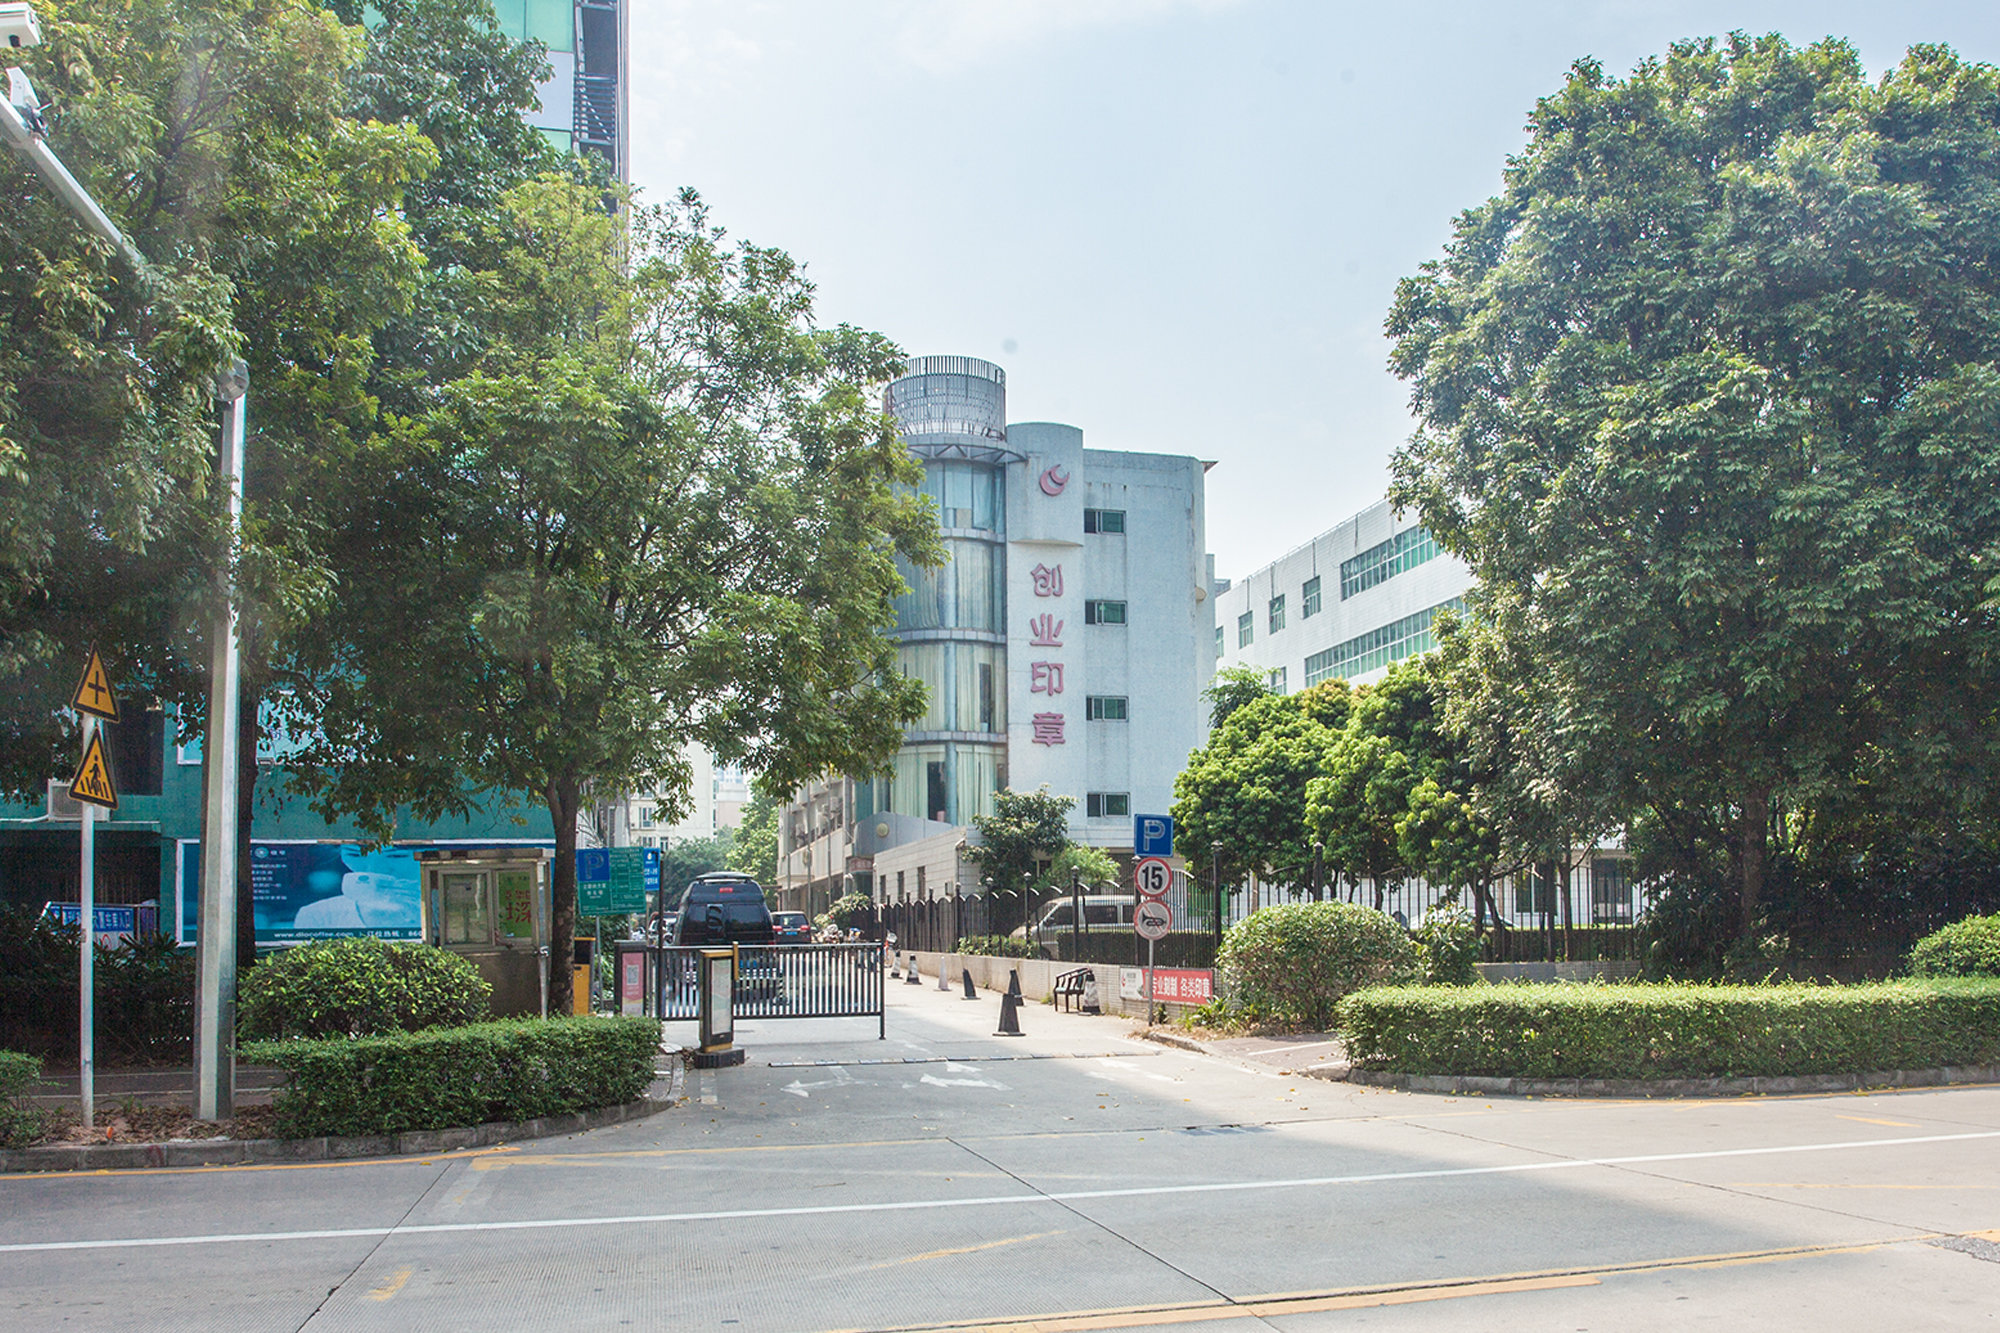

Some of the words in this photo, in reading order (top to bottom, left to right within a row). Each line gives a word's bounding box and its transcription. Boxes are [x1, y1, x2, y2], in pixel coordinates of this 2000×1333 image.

[1030, 563, 1065, 747] 创业印章
[1143, 820, 1165, 851] P
[1142, 866, 1162, 890] 15
[1180, 976, 1211, 999] 各类印章
